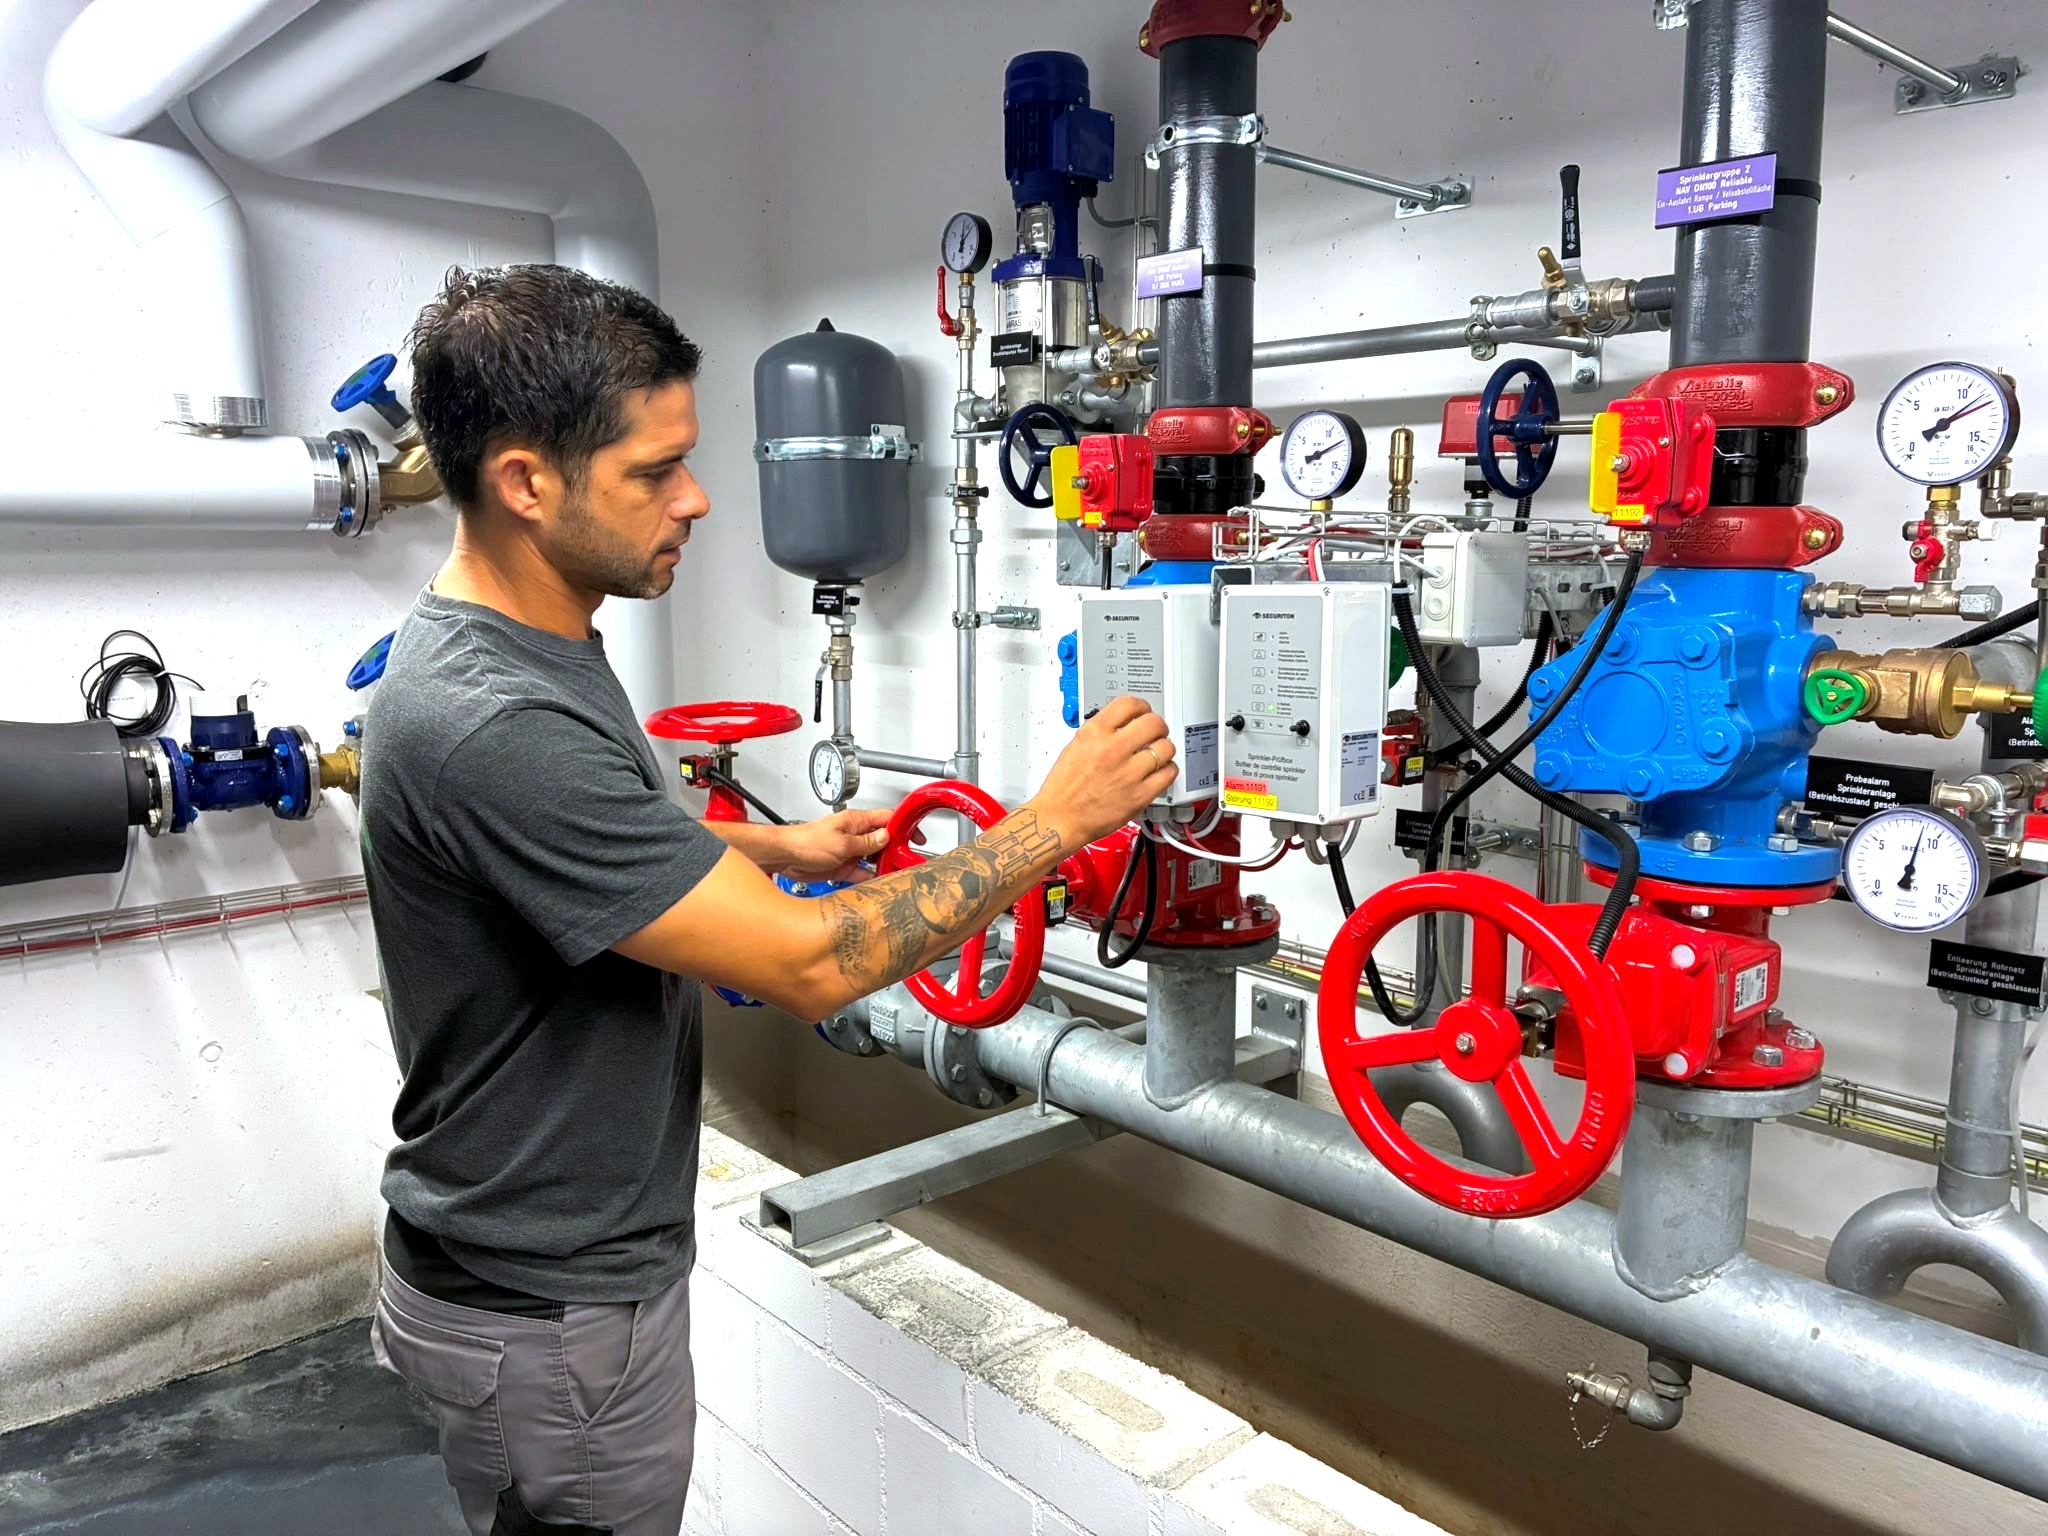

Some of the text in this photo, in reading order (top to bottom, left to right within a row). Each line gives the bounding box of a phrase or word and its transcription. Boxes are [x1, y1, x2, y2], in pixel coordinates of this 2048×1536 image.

[1680, 165, 1751, 185] Sprinklergruppe 2
[1694, 181, 1717, 193] DN100
[1720, 176, 1753, 188] Reliable
[1708, 200, 1738, 211] Parking
[1957, 388, 1968, 400] 10
[1914, 400, 1920, 411] 5
[1302, 437, 1307, 445] 5
[1969, 431, 1981, 442] 15
[1909, 441, 1915, 452] 0
[1331, 461, 1338, 469] 15
[1615, 508, 1641, 517] 11192
[2021, 716, 2034, 725] Ala
[1352, 733, 1378, 741] SECURITON
[2024, 728, 2035, 737] Sp
[1248, 753, 1293, 764] Sprinkler-Prüfbox
[1845, 773, 1890, 786] Probealarm
[1226, 782, 1266, 792] Alarm 11191
[1837, 784, 1896, 799] Sprinkleranlage
[1226, 794, 1274, 807] Störung 11192
[1809, 790, 1870, 807] (Betriebszustand
[1879, 840, 1885, 850] 5
[1927, 838, 1938, 850] 10
[1875, 879, 1881, 889] 0
[1937, 883, 1948, 895] 15
[1947, 954, 2025, 974] Entleerung Rohrnetz
[1956, 965, 2015, 982] Sprinkleranlage
[1931, 968, 2039, 994] (Betriebszustand geschlossen)
